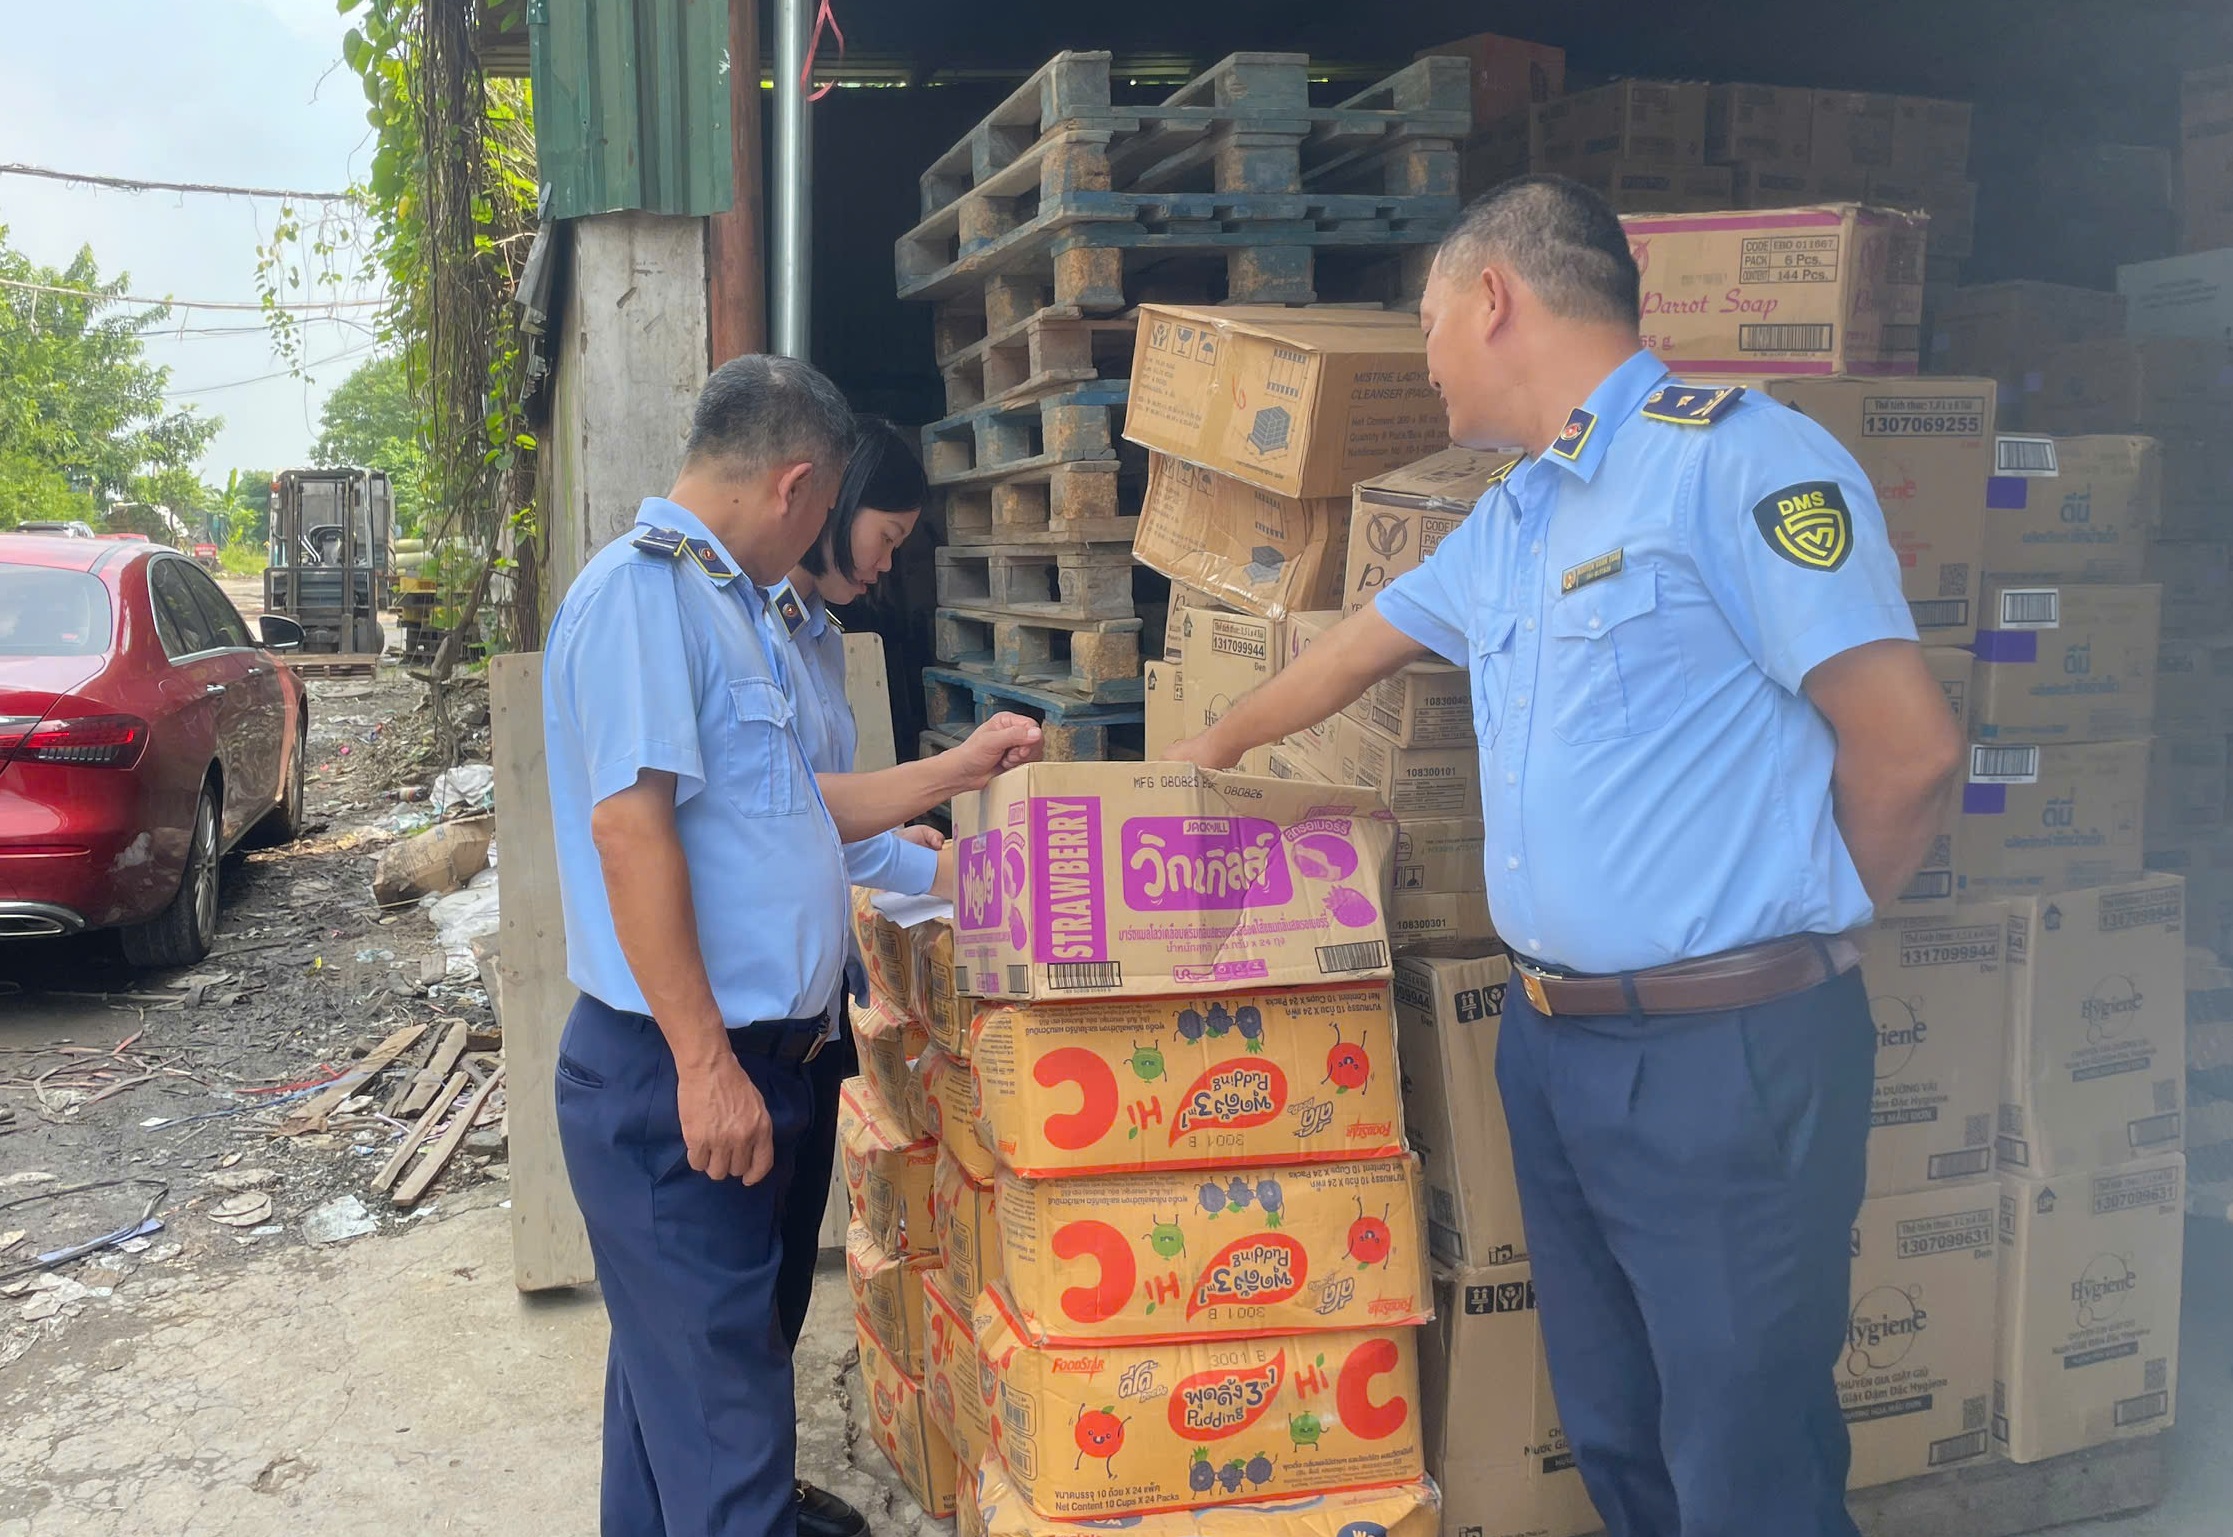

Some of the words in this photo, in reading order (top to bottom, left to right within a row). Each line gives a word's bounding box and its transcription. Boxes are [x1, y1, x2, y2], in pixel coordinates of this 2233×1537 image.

[1746, 241, 1769, 252] CODE
[1745, 255, 1768, 266] PACK
[1784, 255, 1793, 266] 6
[1796, 254, 1822, 266] Pcs.
[1778, 269, 1798, 281] 144
[1802, 269, 1829, 281] Pcs.
[1640, 291, 1710, 320] Parrot
[1719, 288, 1778, 321] Soap
[1351, 388, 1403, 400] CLEANSER
[1866, 416, 1979, 432] 1307069255
[1777, 490, 1826, 517] DMS
[1426, 520, 1450, 532] CODE
[1424, 534, 1445, 546] PAC
[1213, 637, 1265, 657] 1317099944
[1424, 696, 1470, 706] 10830040
[1406, 767, 1456, 777] 108300101
[1133, 777, 1154, 788] MFG
[1224, 785, 1263, 799] 080826
[1047, 800, 1094, 958] STRAWBERRY
[1397, 919, 1447, 929] 108300301
[1902, 944, 1997, 964] 1317099944
[1327, 994, 1336, 1003] 10
[1338, 993, 1367, 1002] Content
[1369, 992, 1381, 1001] Net
[1394, 984, 1430, 1010] 099944
[1337, 1005, 1345, 1014] 10
[1877, 1022, 1927, 1047] iene
[1212, 1070, 1268, 1091] Pudding
[1033, 1047, 1118, 1150] C
[1194, 1092, 1213, 1116] 3
[1215, 1090, 1272, 1121] พุดดิ้ง
[1127, 1095, 1162, 1135] Hi
[1181, 1112, 1189, 1129] 1
[1188, 1136, 1197, 1147] B
[1208, 1134, 1244, 1146] 3001
[1289, 1170, 1311, 1179] Packs
[1352, 1165, 1361, 1174] 10
[1363, 1164, 1391, 1174] Content
[1361, 1177, 1369, 1185] 10
[1901, 1229, 1990, 1254] 1307099631
[1232, 1246, 1288, 1268] Pudding
[1052, 1220, 1136, 1323] C
[1213, 1269, 1231, 1292] 3
[1234, 1267, 1292, 1298] พุดดิ้ง
[2071, 1271, 2136, 1304] Hygiene
[1144, 1271, 1180, 1311] Hi
[1199, 1289, 1208, 1304] 1
[1208, 1309, 1217, 1320] B
[1228, 1307, 1265, 1319] 3001
[1210, 1352, 1248, 1367] 3001
[1256, 1350, 1266, 1362] B
[1185, 1378, 1243, 1410] พุดดิ้ง
[1245, 1381, 1263, 1406] 3
[1268, 1368, 1276, 1384] 1
[1294, 1357, 1329, 1399] Hi
[1337, 1338, 1407, 1440] C
[1187, 1406, 1244, 1428] Pudding
[1097, 1489, 1106, 1498] 10
[1132, 1487, 1141, 1495] 24
[1055, 1502, 1069, 1511] Net
[1071, 1500, 1103, 1511] Content
[1105, 1500, 1114, 1509] 10
[1116, 1498, 1136, 1508] Cups
[1145, 1496, 1154, 1504] 24
[1156, 1493, 1180, 1502] Packs
